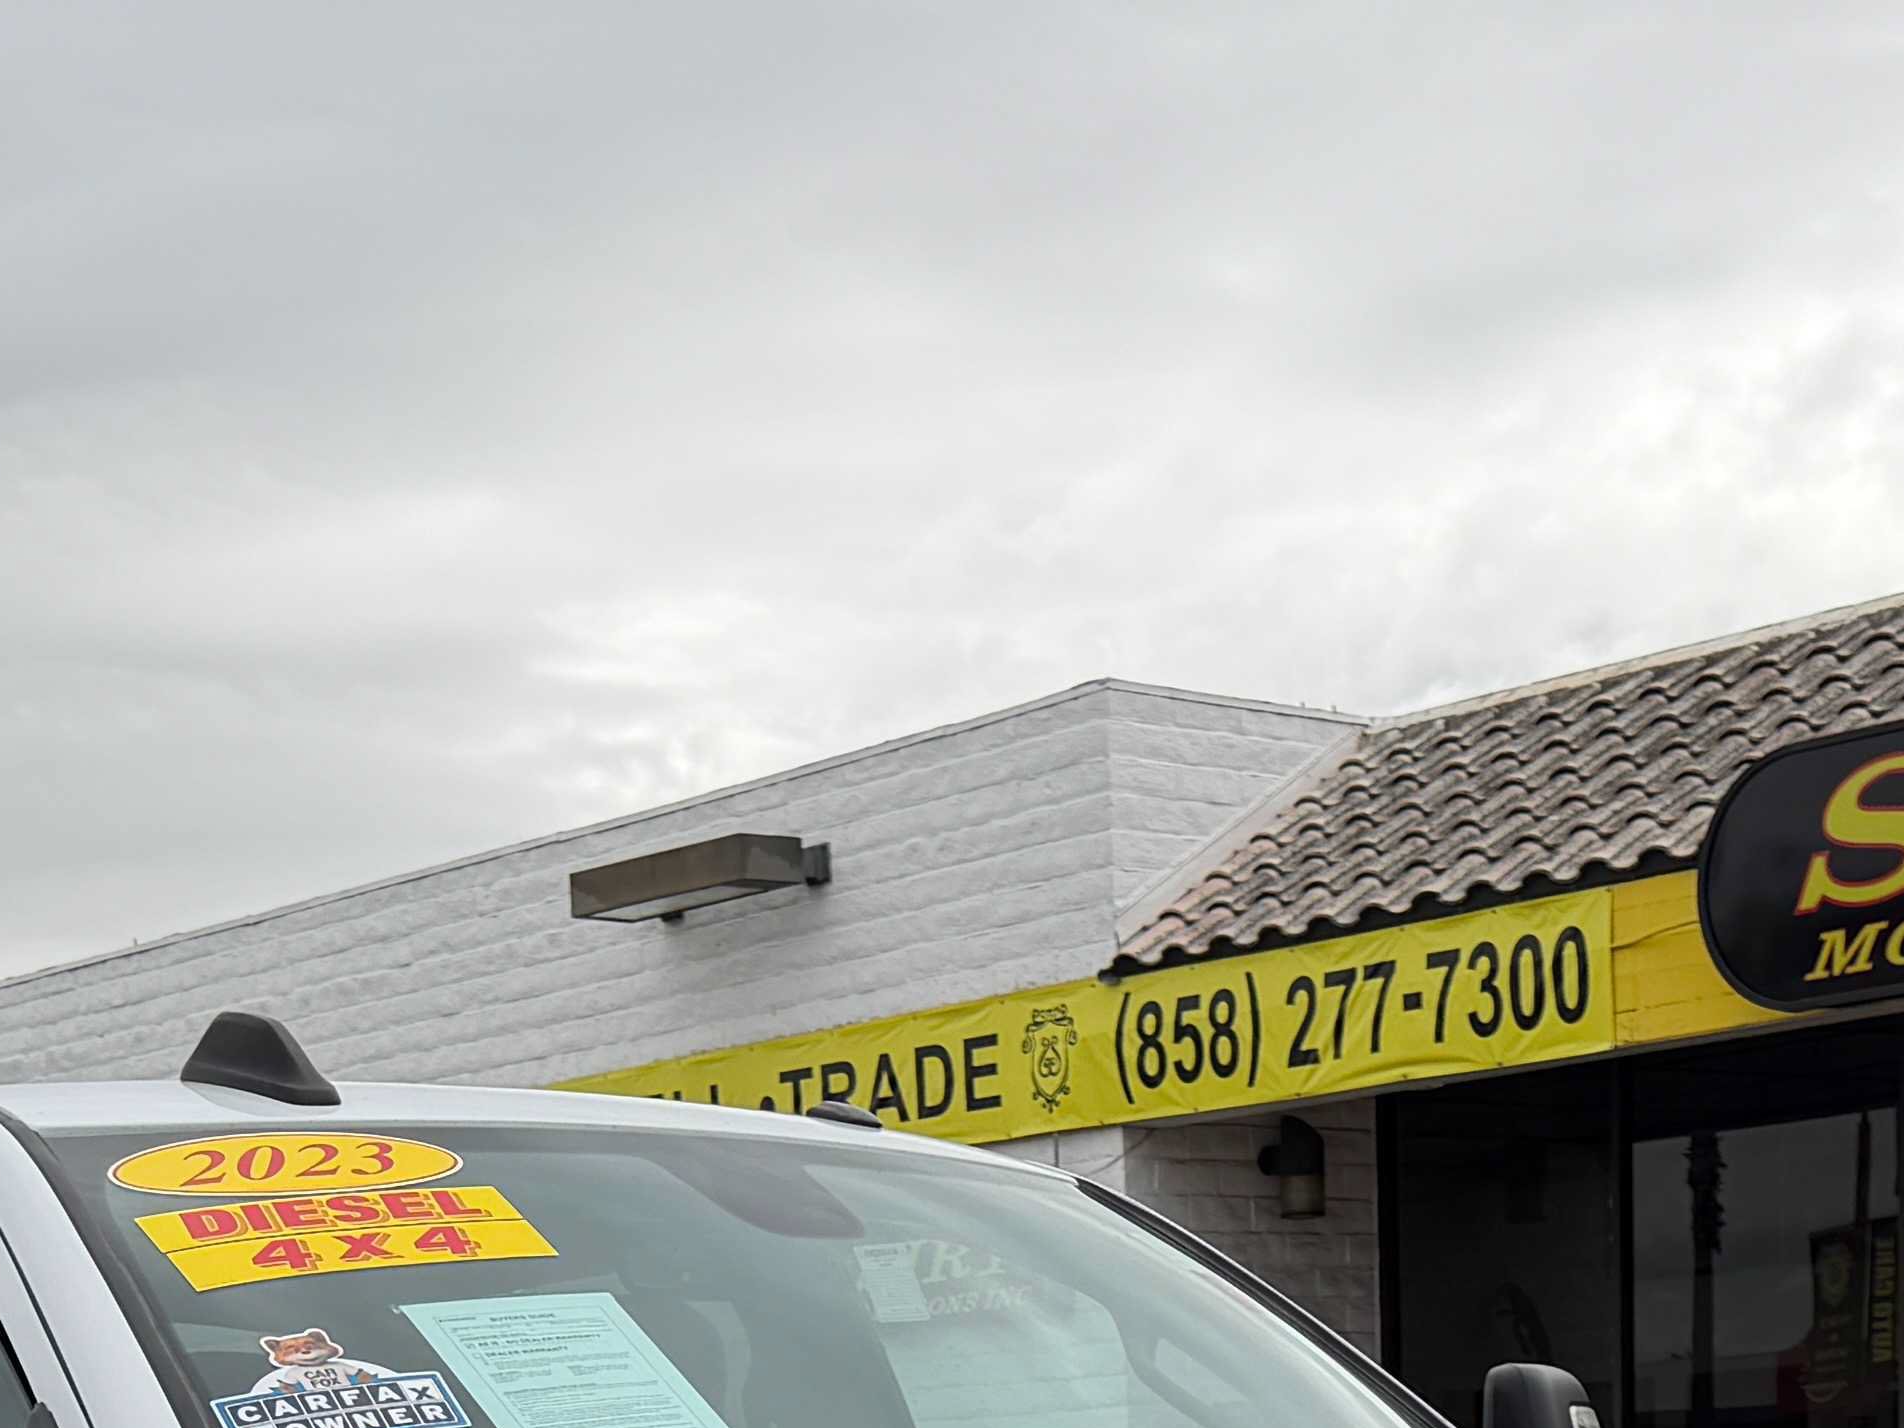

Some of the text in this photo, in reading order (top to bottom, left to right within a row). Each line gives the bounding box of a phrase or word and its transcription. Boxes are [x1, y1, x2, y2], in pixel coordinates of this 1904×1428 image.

[1113, 924, 1590, 1105] (858) 277-7300
[179, 1142, 395, 1187] 2023
[179, 1190, 492, 1241] DIESEL
[237, 1385, 436, 1423] CARFAX
